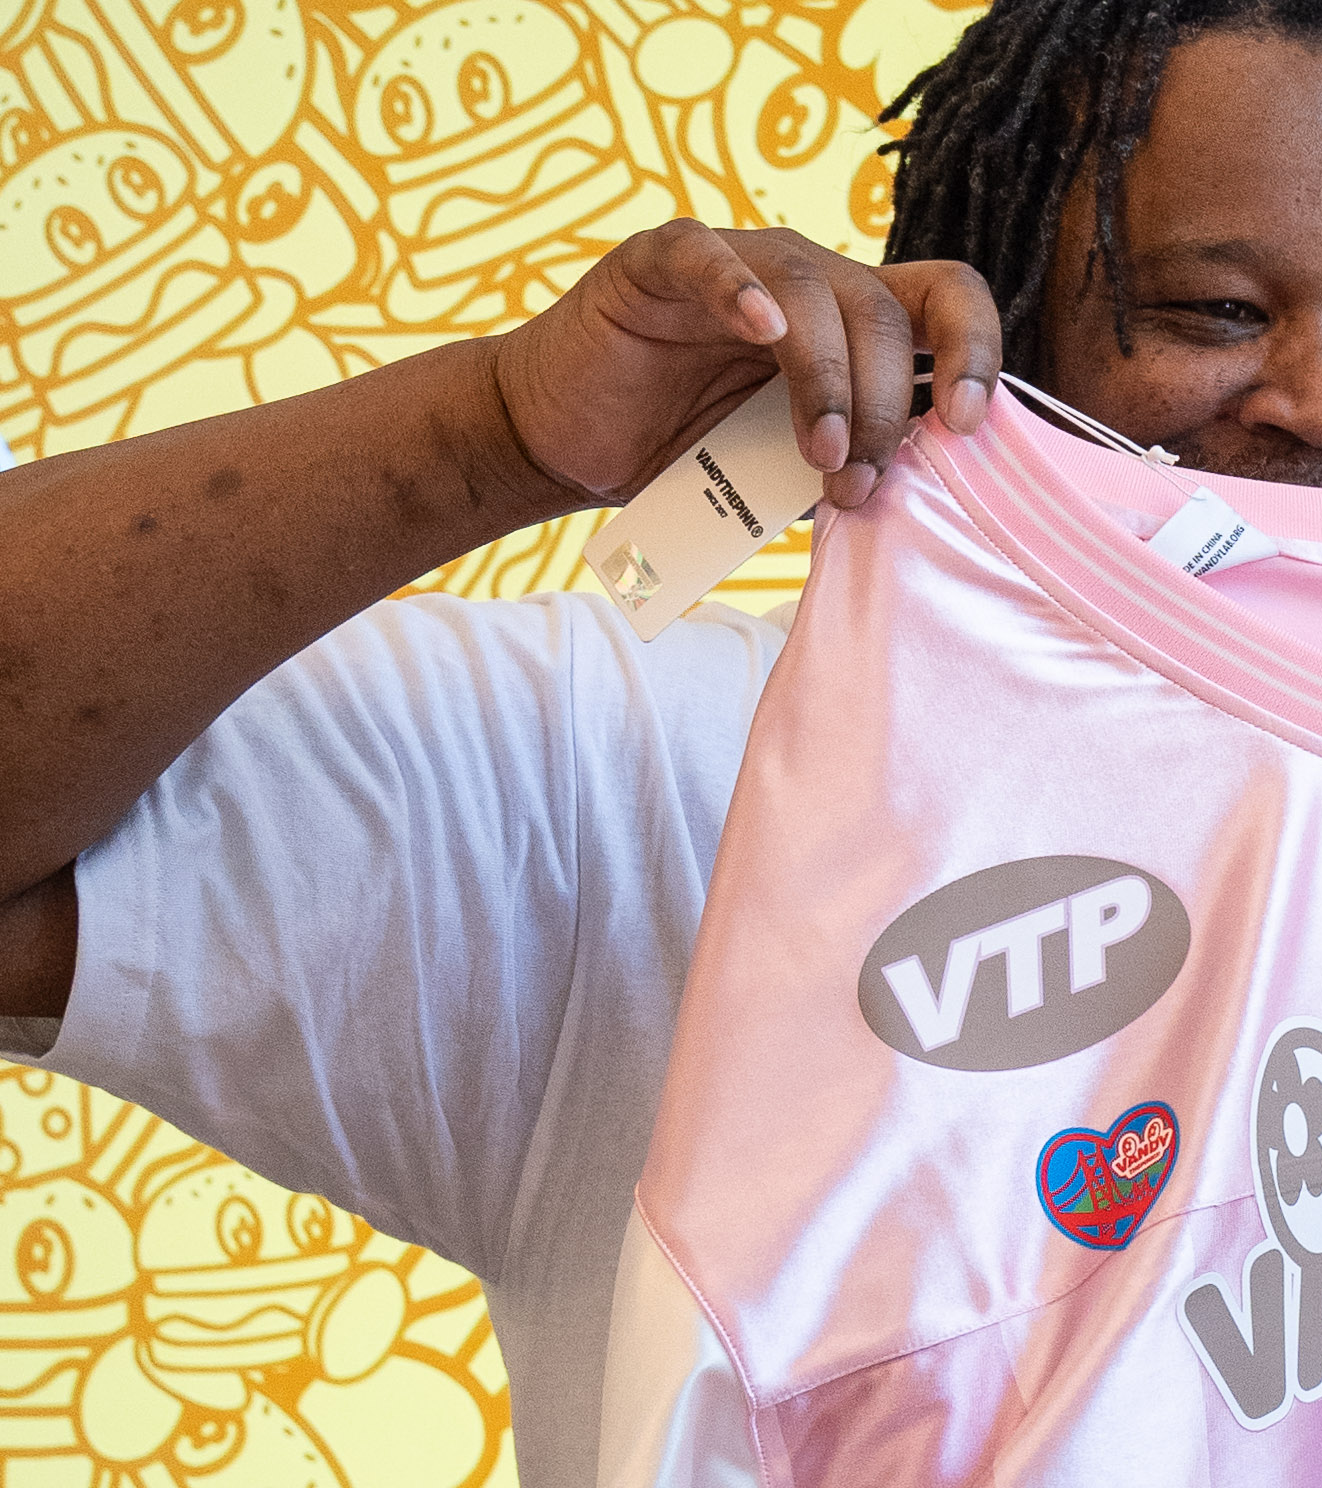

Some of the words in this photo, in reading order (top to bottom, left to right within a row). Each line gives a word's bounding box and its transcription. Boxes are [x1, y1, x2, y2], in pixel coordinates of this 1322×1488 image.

[695, 447, 764, 538] VANDYTHEPINK®
[1192, 551, 1204, 564] IN
[1201, 531, 1223, 554] CHINA
[1193, 524, 1246, 578] VANDYLAB.ORG
[881, 874, 1153, 1051] VTP
[1114, 1132, 1171, 1173] VANDY
